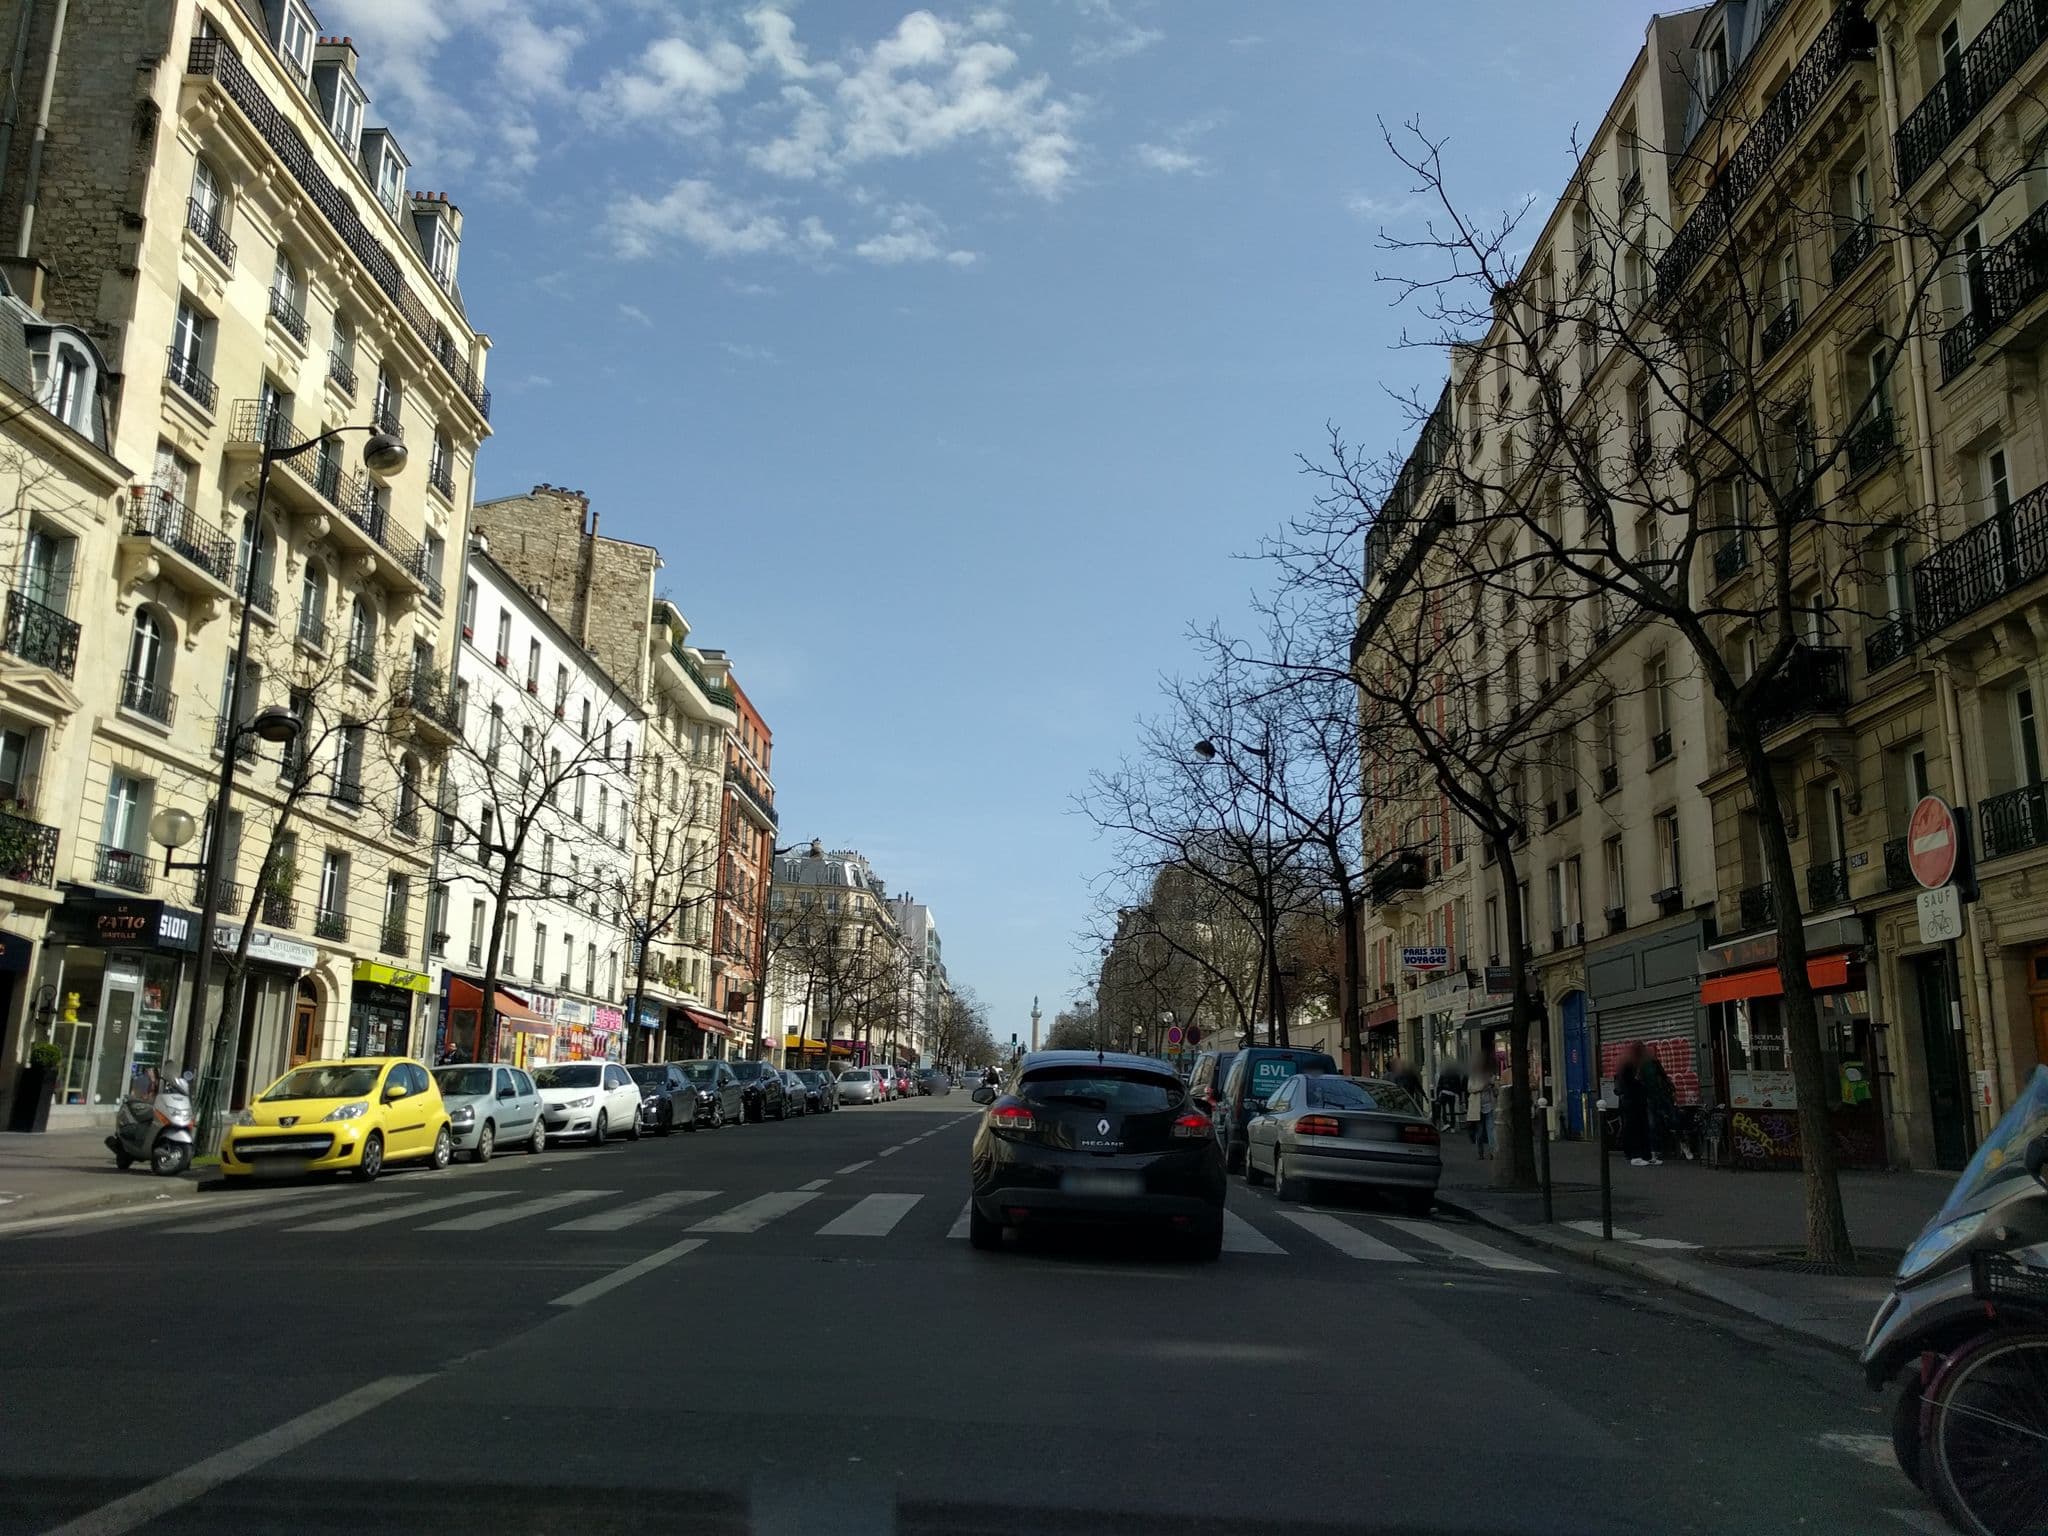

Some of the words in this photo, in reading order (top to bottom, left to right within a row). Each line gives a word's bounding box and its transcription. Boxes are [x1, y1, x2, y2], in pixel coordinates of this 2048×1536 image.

[1924, 889, 1951, 908] SAUF
[97, 915, 146, 929] PATIO
[1403, 956, 1447, 964] VOYAGES
[1259, 1064, 1290, 1078] BVL
